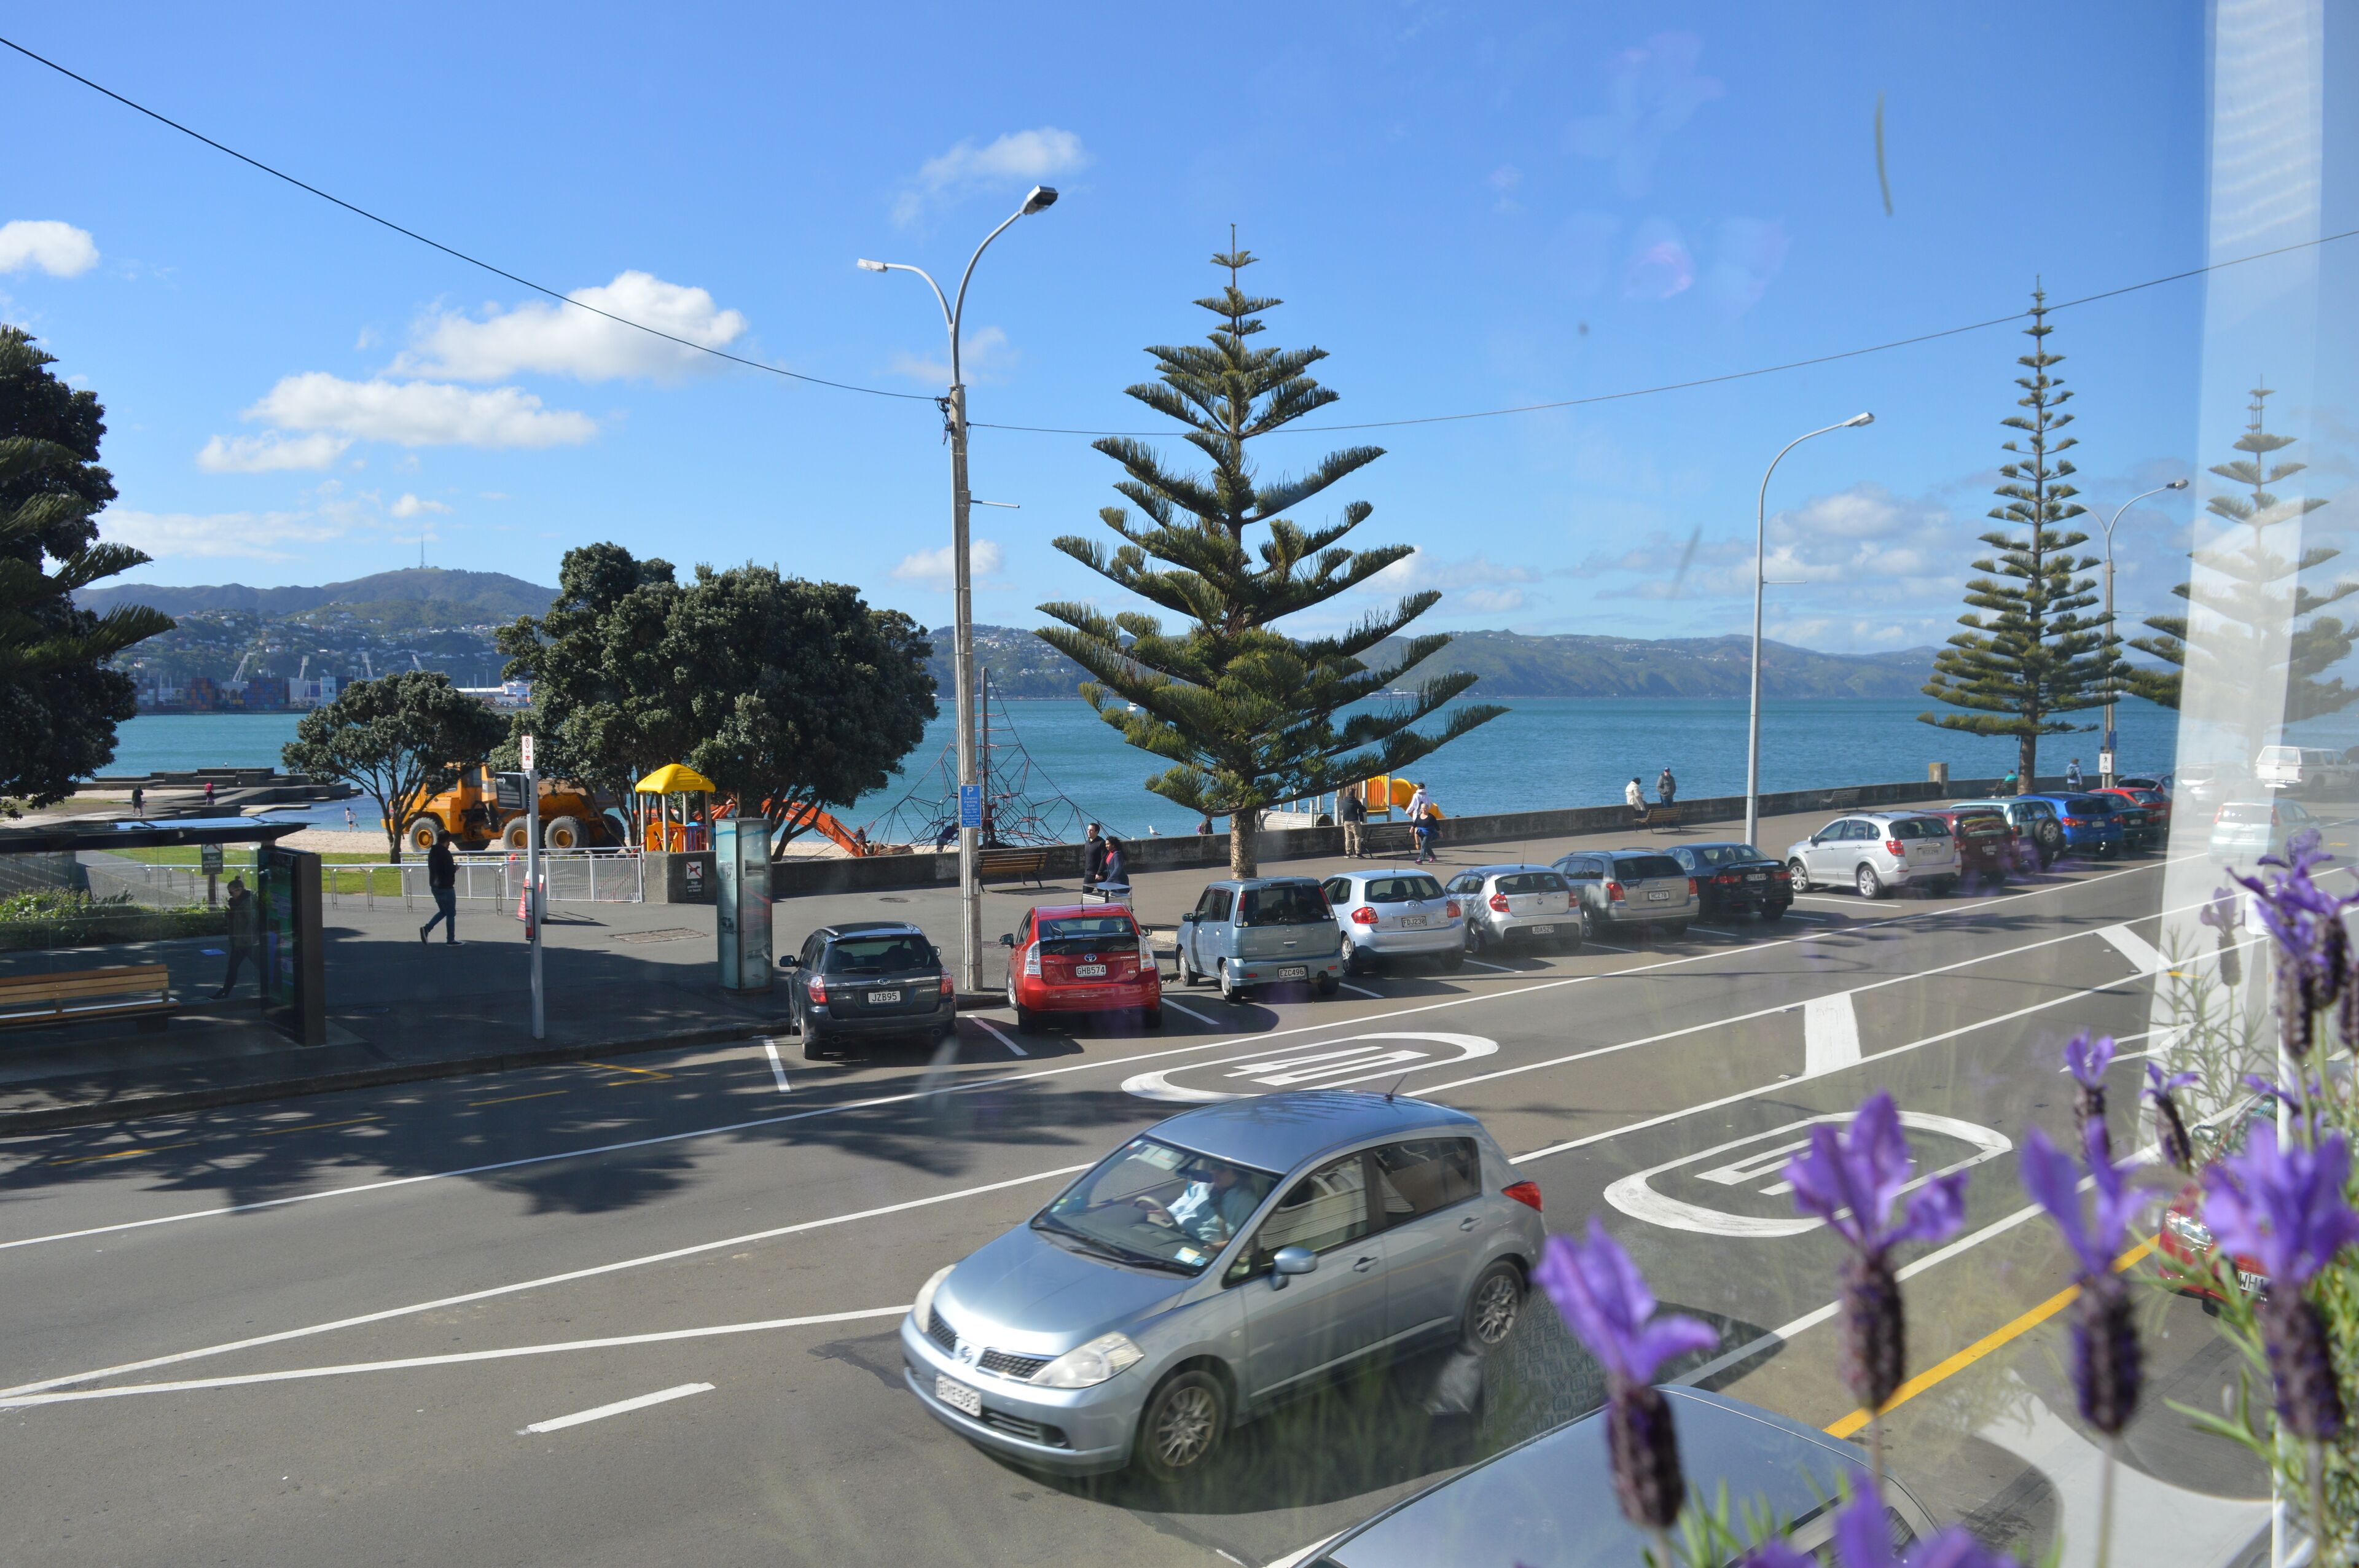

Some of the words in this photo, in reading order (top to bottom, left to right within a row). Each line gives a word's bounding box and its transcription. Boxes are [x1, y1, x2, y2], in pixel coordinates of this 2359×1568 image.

[967, 786, 974, 796] P
[1077, 966, 1105, 975] GHB574
[1280, 968, 1304, 977] EZC496
[872, 993, 897, 1002] JZB95
